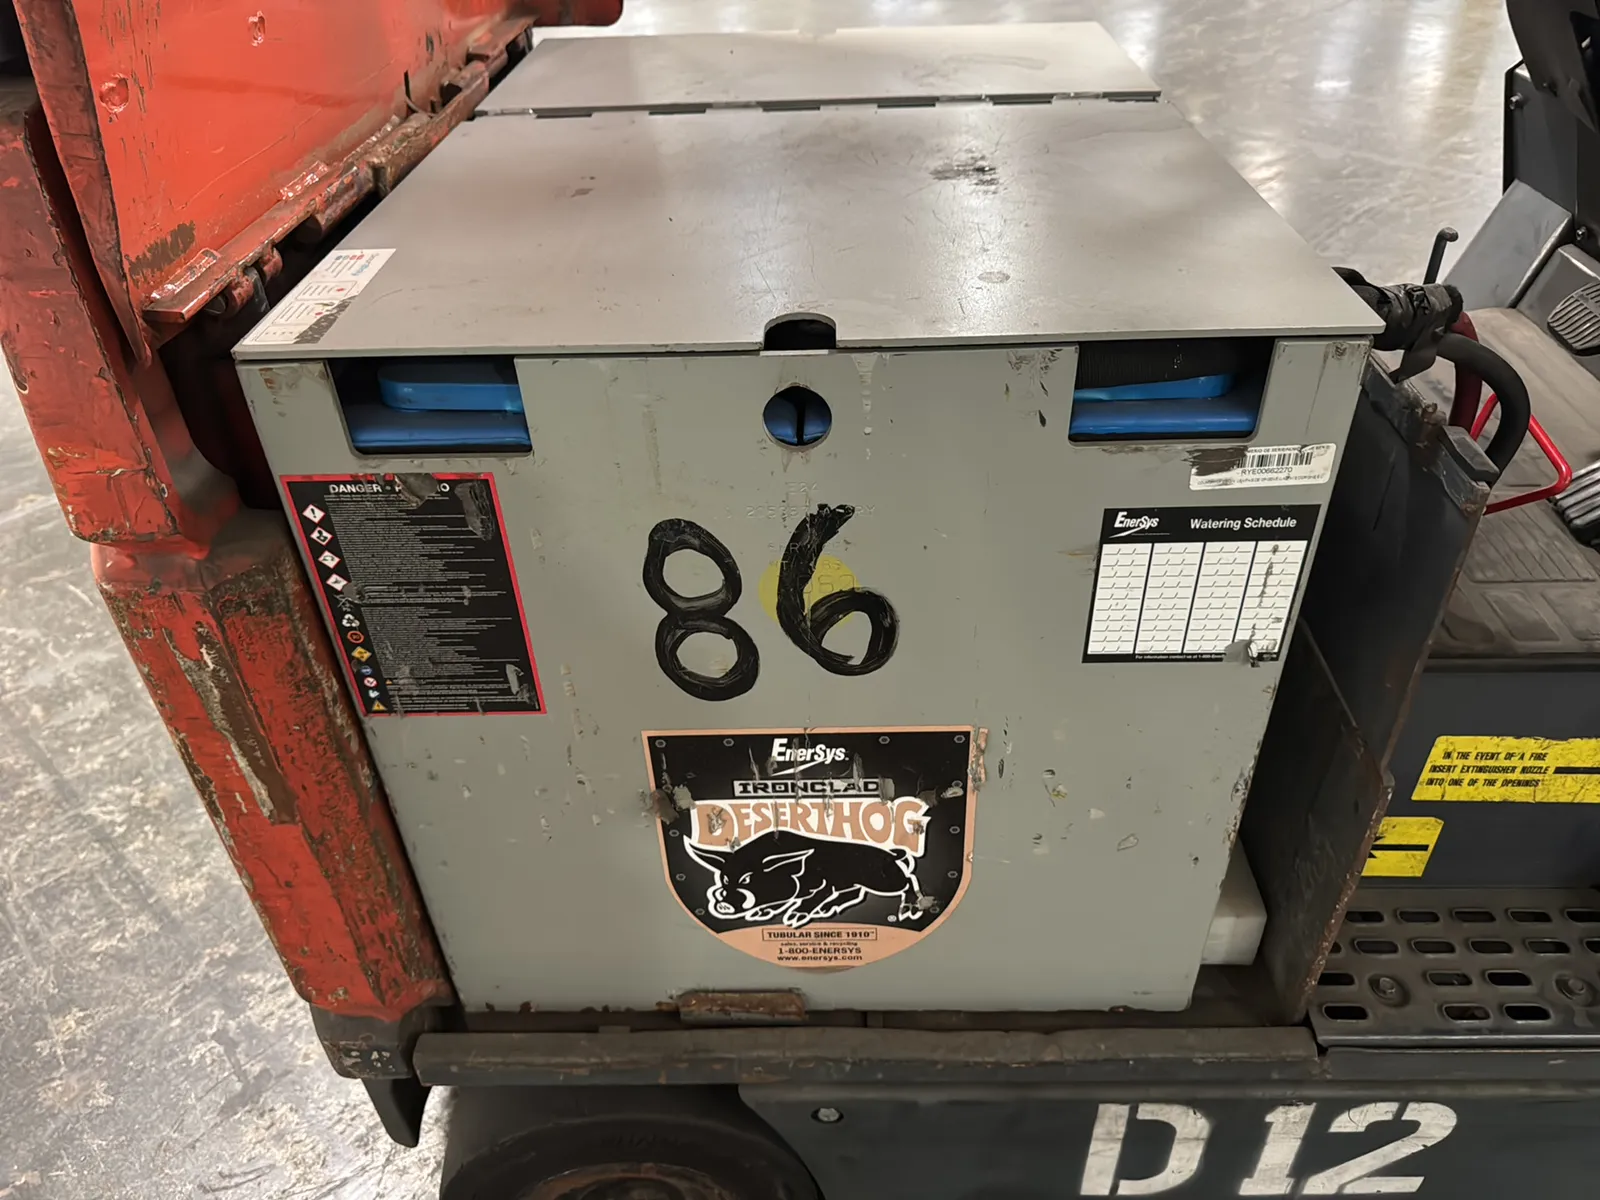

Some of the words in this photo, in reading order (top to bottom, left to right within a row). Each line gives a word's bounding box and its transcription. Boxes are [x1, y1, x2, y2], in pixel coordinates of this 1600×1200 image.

[329, 483, 383, 493] DANGER
[1113, 511, 1160, 530] EnerSys
[1190, 518, 1241, 531] Watering
[1243, 516, 1297, 529] Schedule
[643, 503, 899, 701] 86
[1442, 751, 1452, 760] IN
[1456, 752, 1472, 760] THE
[1474, 752, 1501, 760] EVENT
[1504, 752, 1516, 760] OF
[1518, 752, 1525, 761] A
[1528, 753, 1548, 761] FIRE
[1428, 765, 1457, 773] INSERT
[1460, 765, 1517, 774] EXTINGUISHER
[1520, 766, 1550, 774] NOZZLE
[739, 780, 880, 794] IRONCLAD
[1425, 778, 1444, 786] INTO
[1448, 778, 1465, 786] ONE
[1500, 779, 1541, 787] OPENINGS
[697, 800, 925, 853] DESERTHOG
[767, 931, 812, 939] TUBULAR
